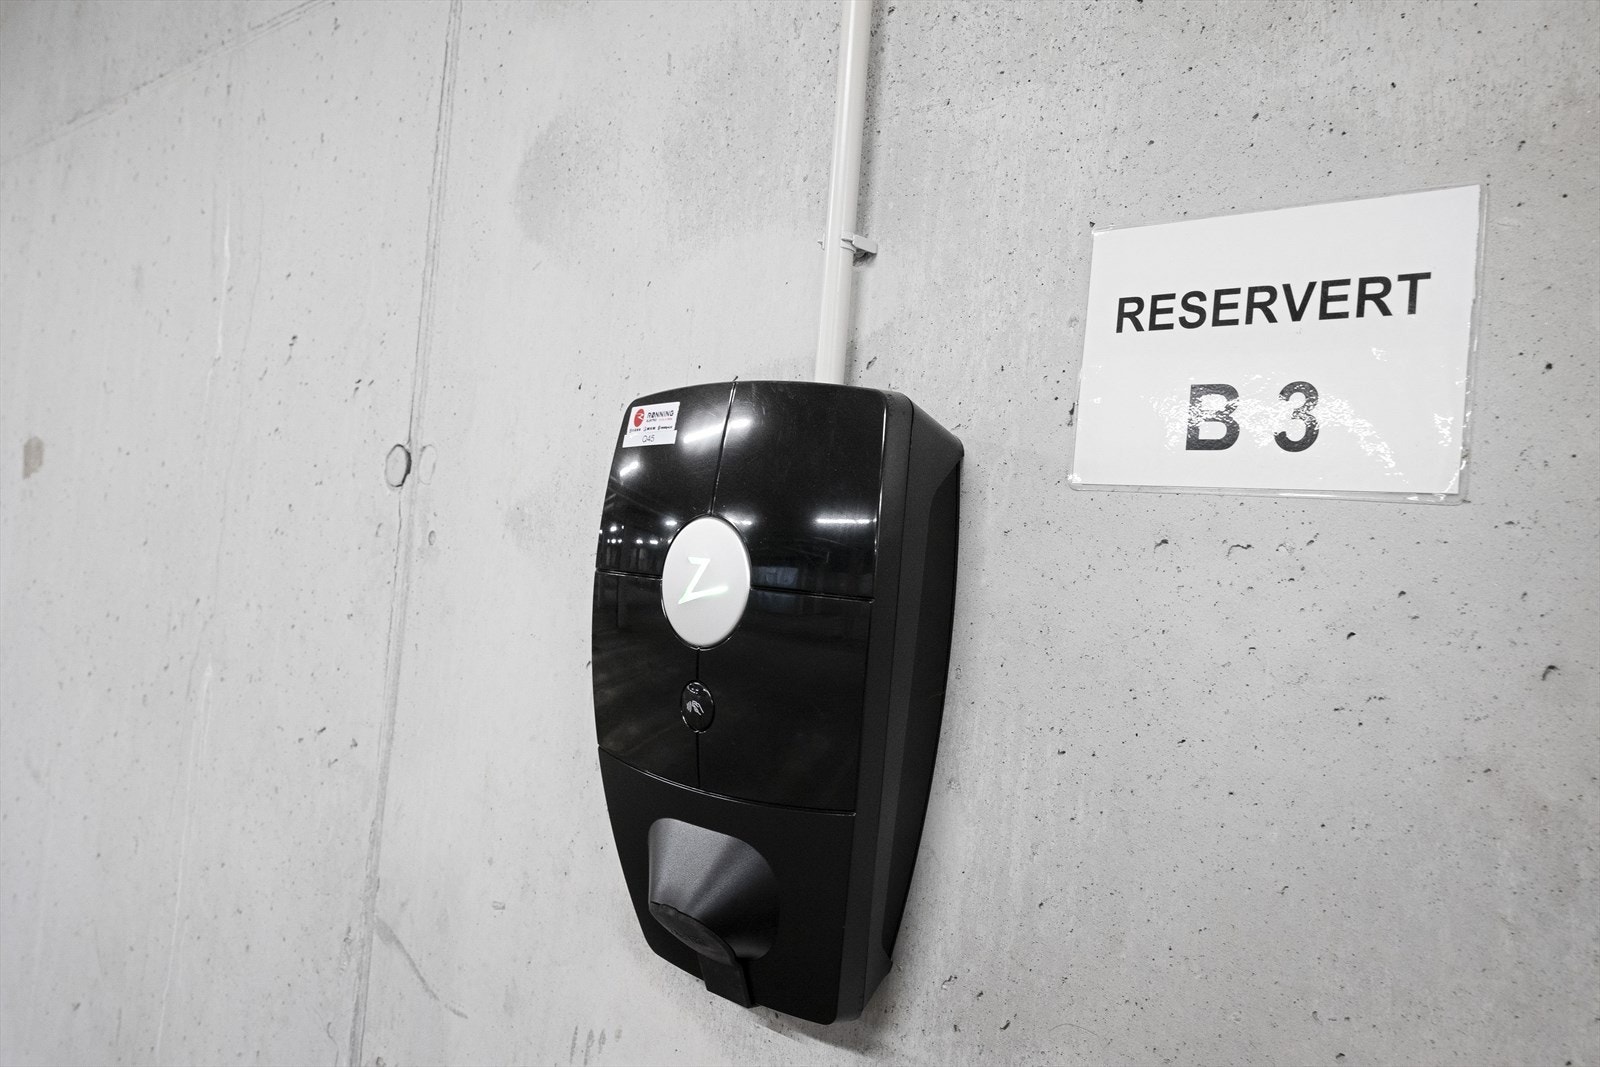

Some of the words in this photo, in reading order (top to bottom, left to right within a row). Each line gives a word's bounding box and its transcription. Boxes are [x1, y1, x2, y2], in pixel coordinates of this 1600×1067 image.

[1116, 272, 1431, 333] RESERVERT
[1185, 383, 1240, 451] B
[1273, 380, 1319, 453] 3
